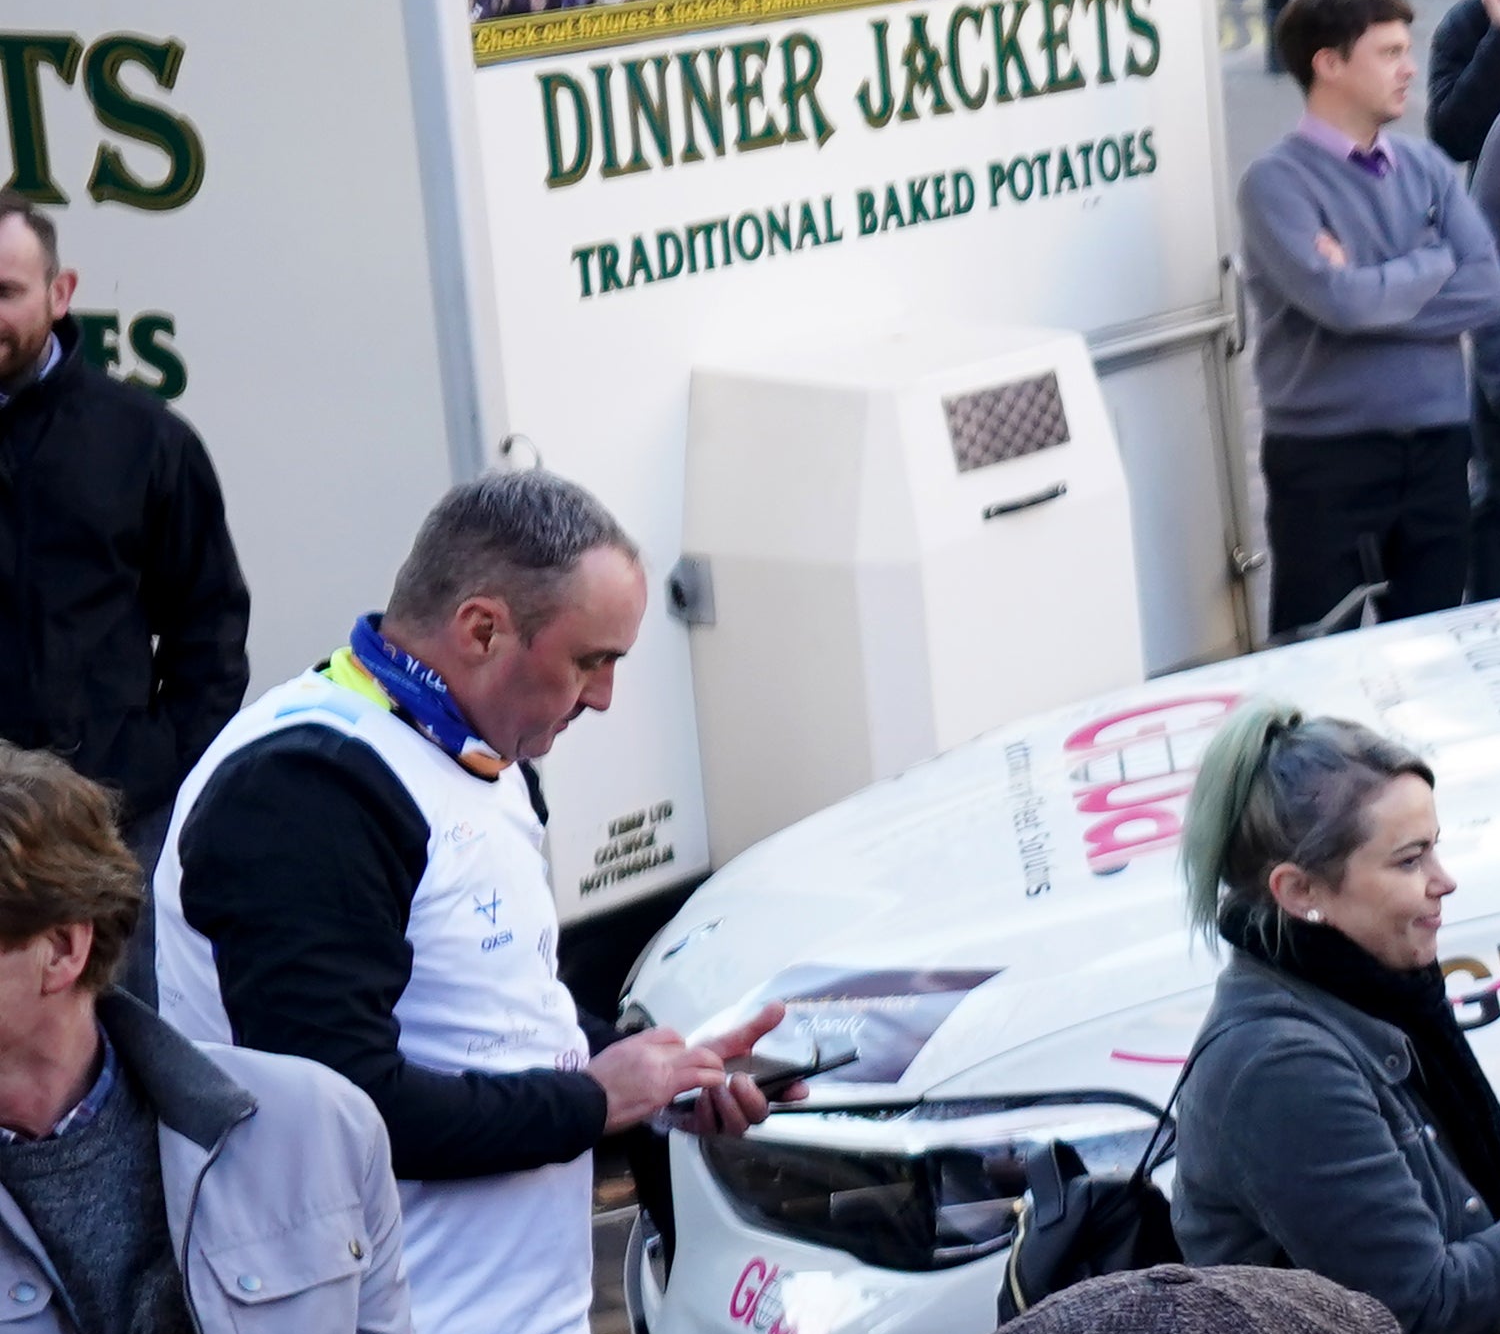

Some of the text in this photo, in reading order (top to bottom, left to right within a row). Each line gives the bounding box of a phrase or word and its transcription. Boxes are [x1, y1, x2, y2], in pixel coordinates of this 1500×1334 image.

[476, 23, 538, 53] Check
[542, 19, 575, 41] out
[576, 9, 649, 40] fixtures
[535, 29, 835, 189] DINNER
[571, 126, 1159, 301] TRADITIONAL BAKED POTATOES
